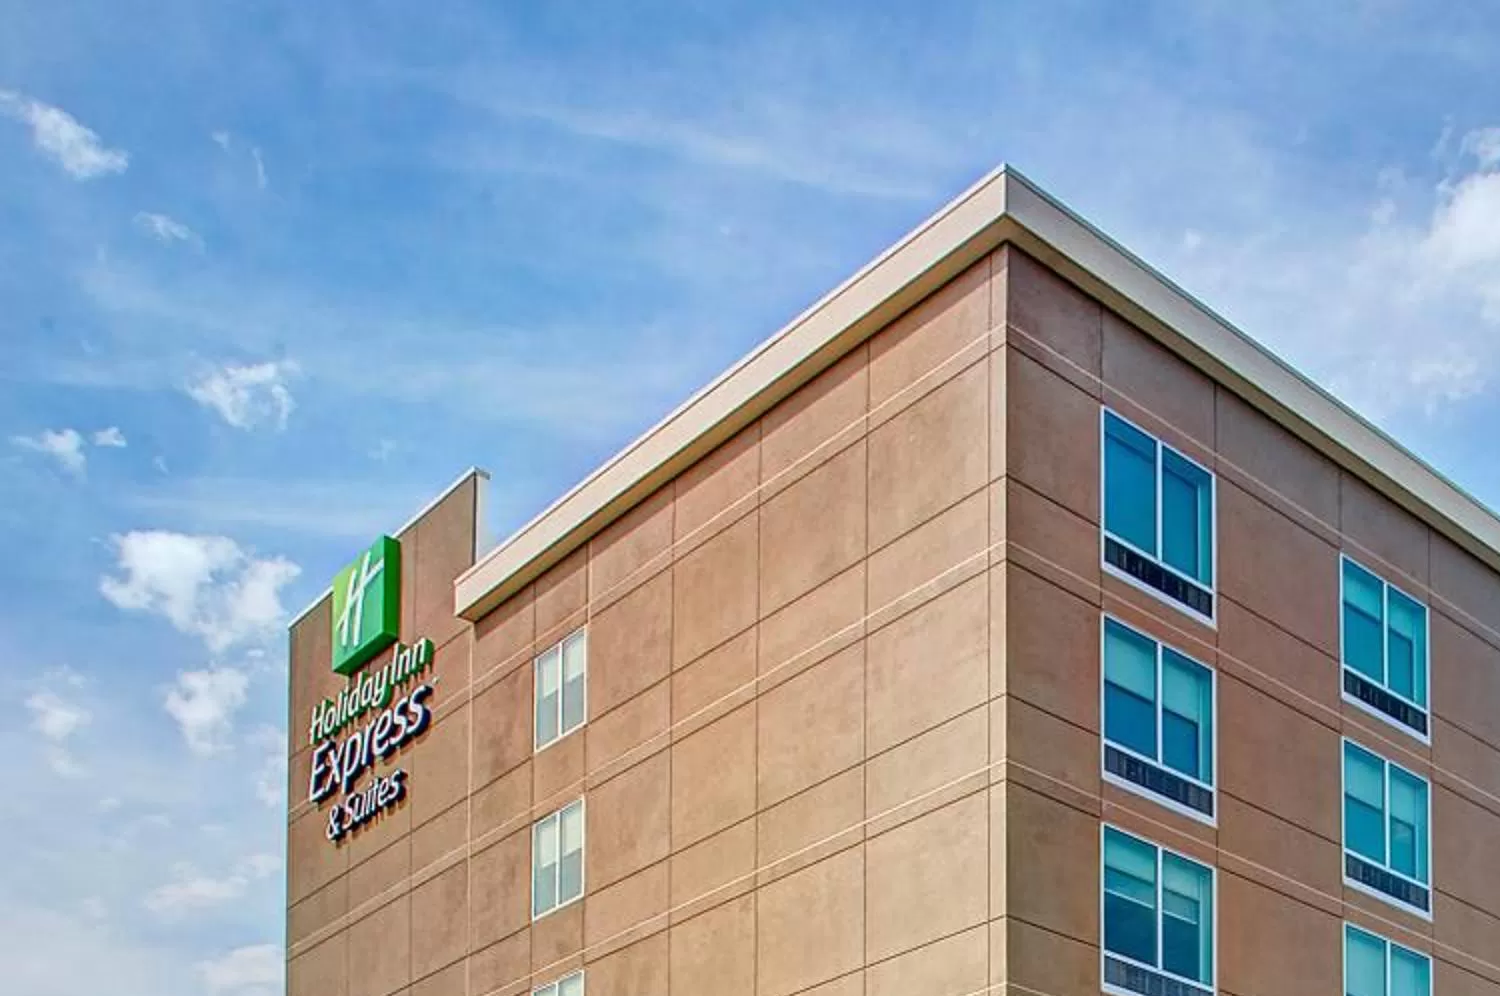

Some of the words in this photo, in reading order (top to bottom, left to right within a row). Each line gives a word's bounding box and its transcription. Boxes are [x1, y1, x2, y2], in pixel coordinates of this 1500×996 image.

[336, 551, 384, 647] H
[310, 665, 391, 745] Holiday
[390, 638, 429, 685] Inn
[309, 684, 433, 802] Express
[326, 804, 341, 840] &
[342, 769, 404, 829] Suites
